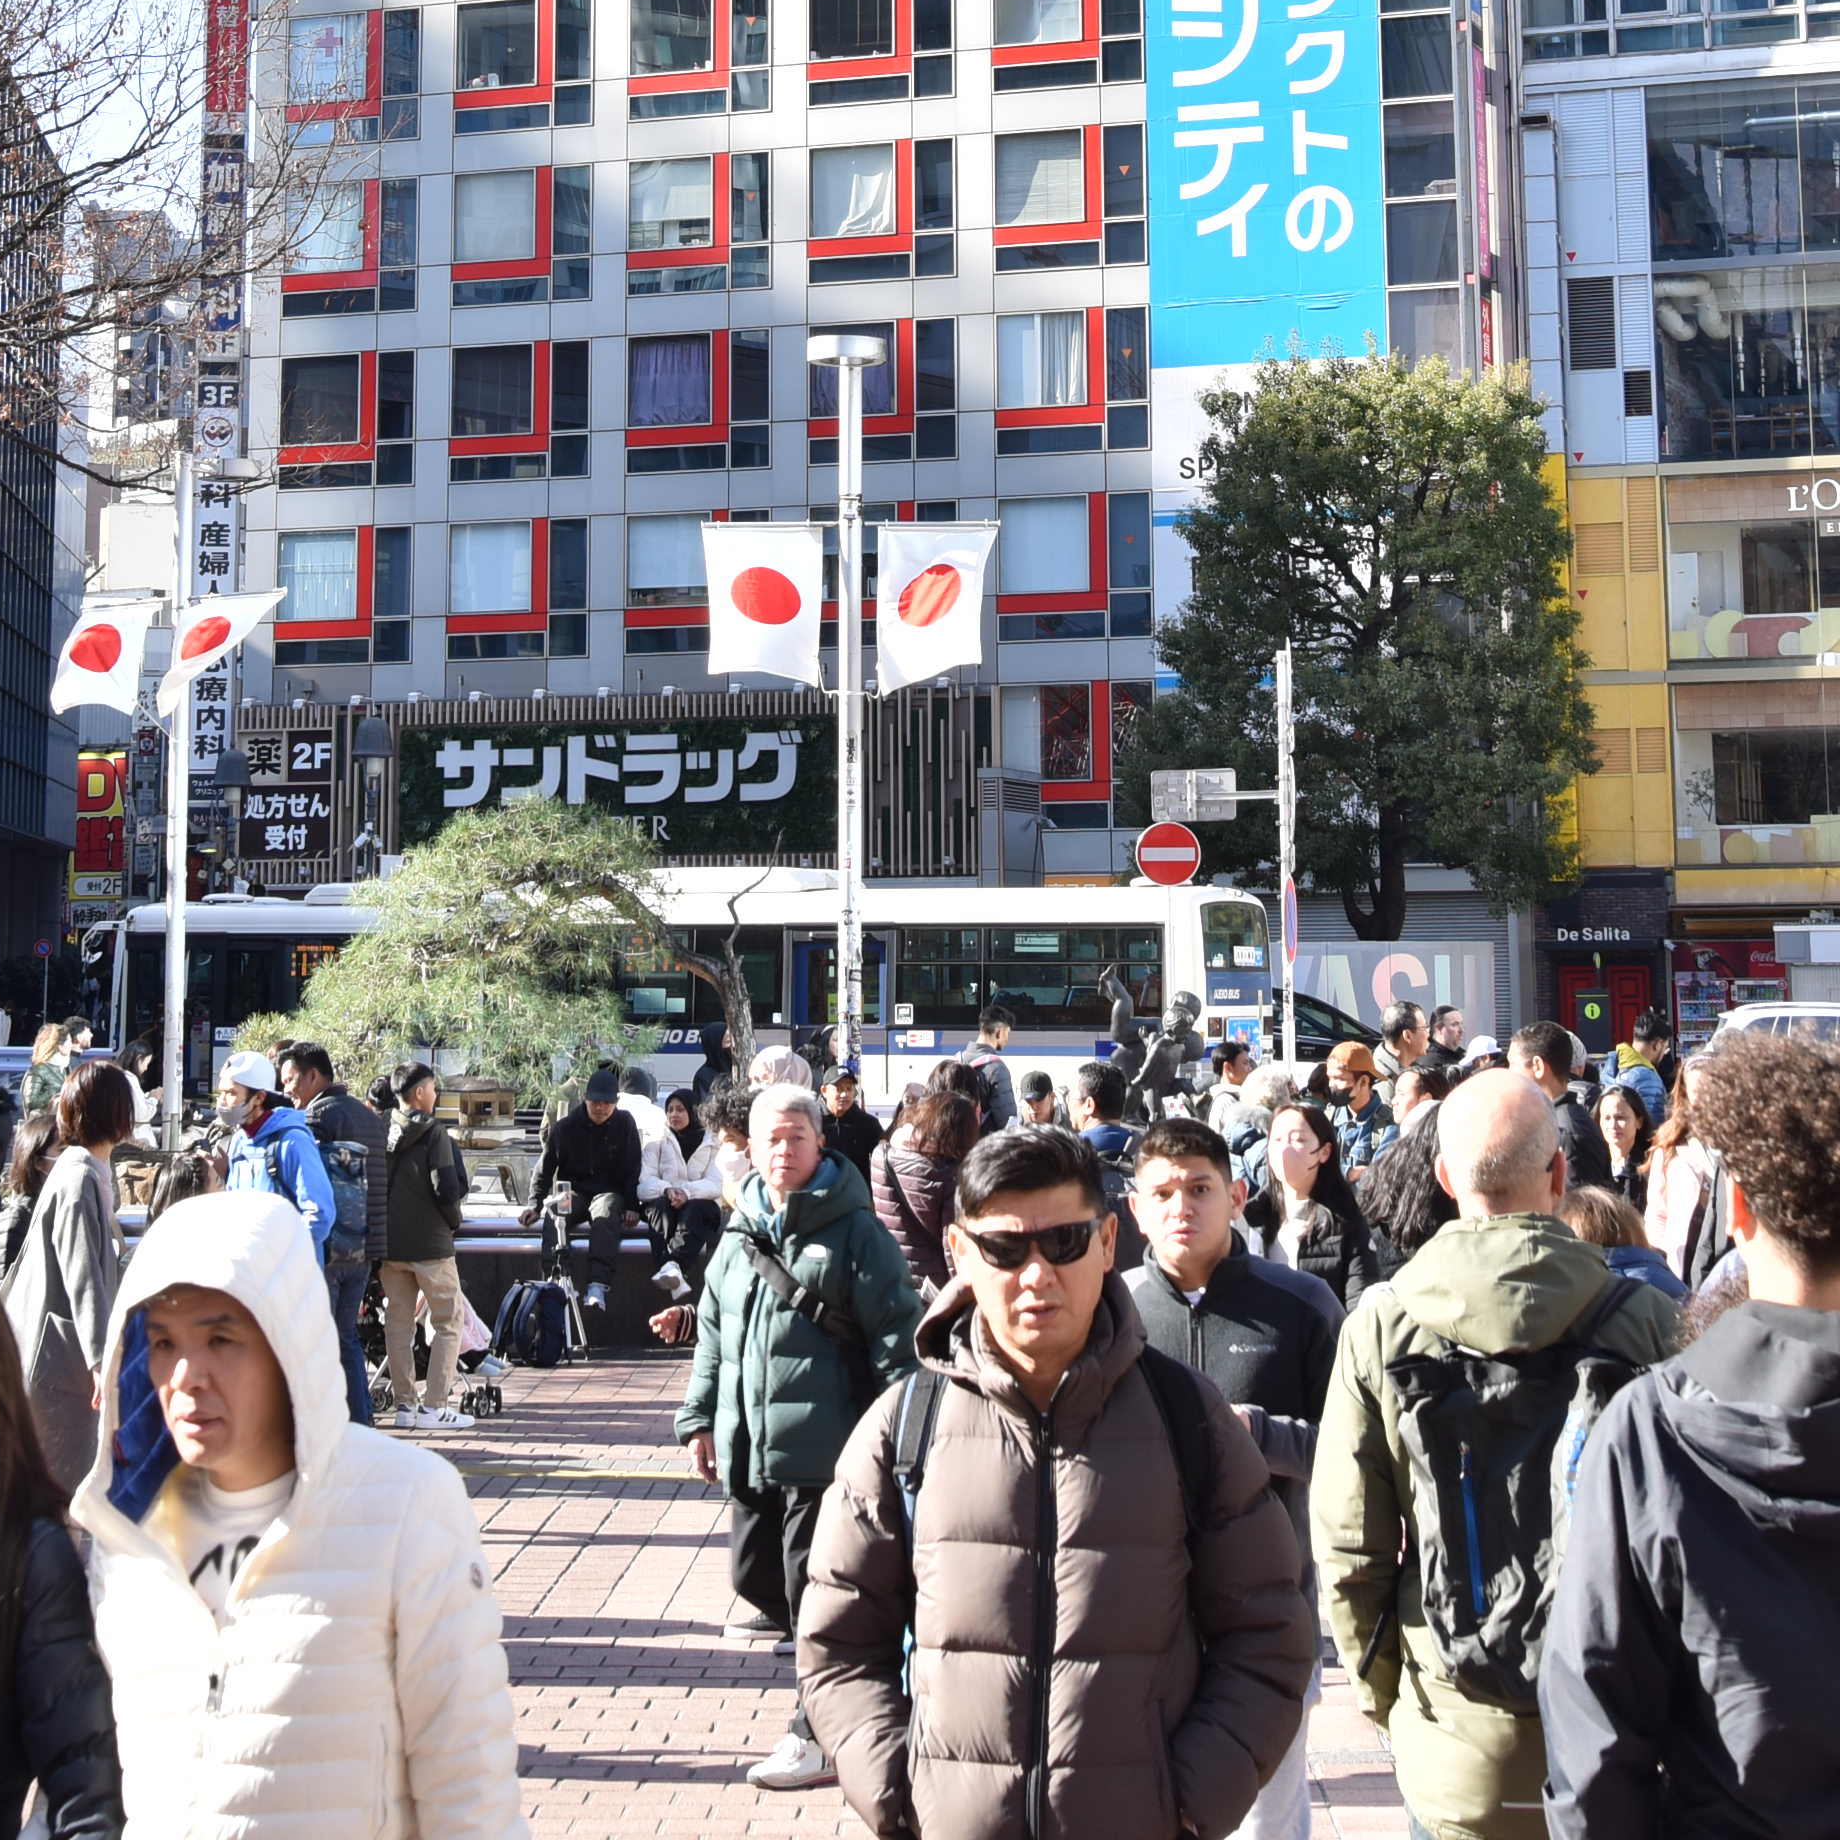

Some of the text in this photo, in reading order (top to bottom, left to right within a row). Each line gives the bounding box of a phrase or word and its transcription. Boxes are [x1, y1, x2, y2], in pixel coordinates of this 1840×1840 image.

[203, 386, 235, 406] 3F
[246, 737, 282, 778] 薬
[292, 741, 333, 772] 2F
[434, 730, 804, 809] サンドラッグ
[244, 793, 332, 820] 処方せん
[264, 824, 309, 852] 受付
[1556, 926, 1631, 943] De Salita
[1213, 988, 1241, 1001] KEIO BUS
